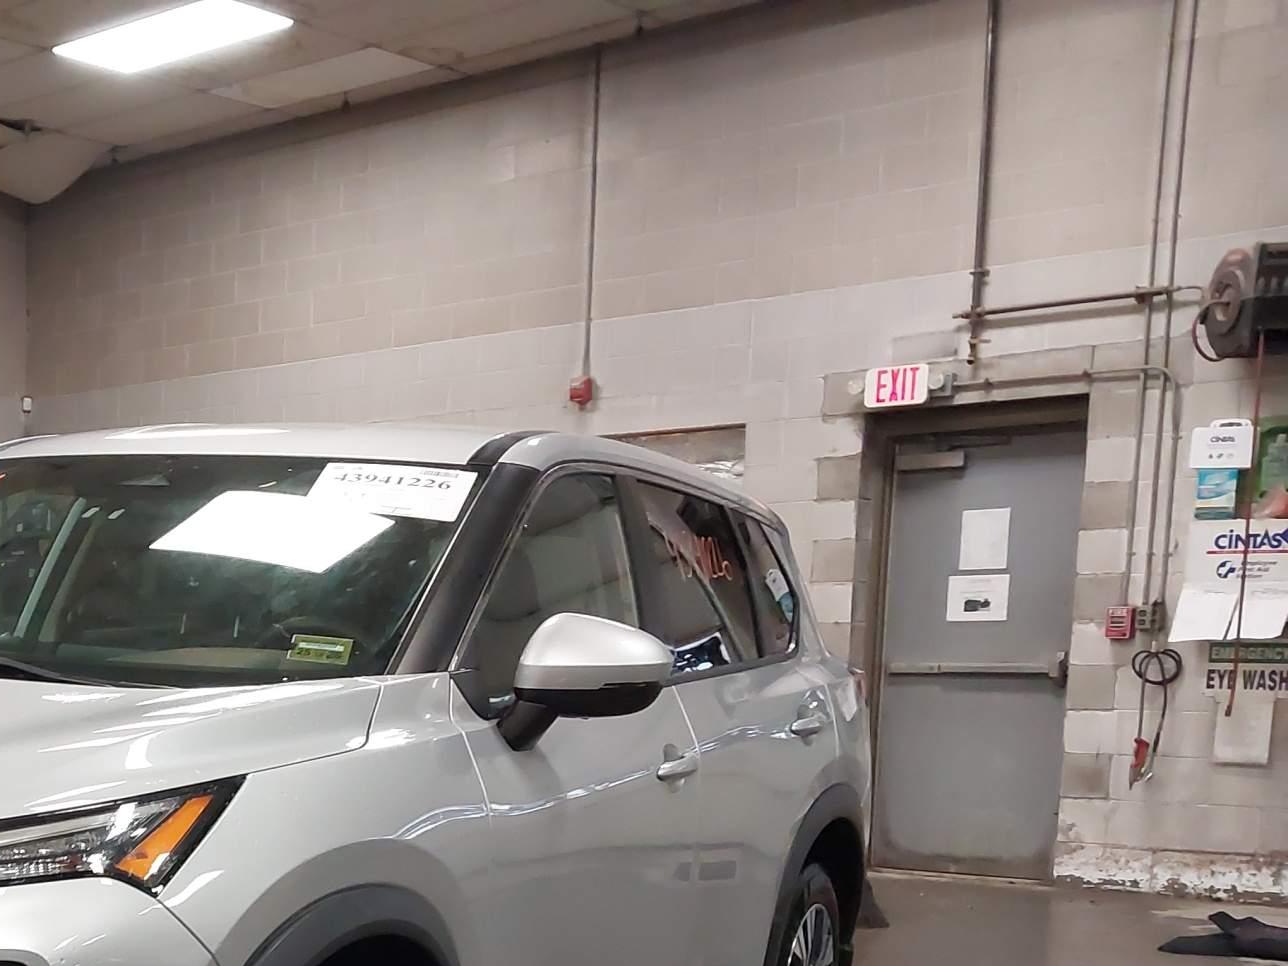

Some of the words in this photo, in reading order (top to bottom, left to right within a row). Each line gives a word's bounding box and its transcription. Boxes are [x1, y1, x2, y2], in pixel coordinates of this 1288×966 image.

[875, 367, 920, 403] EXIT
[333, 473, 452, 490] 43941226
[1243, 669, 1288, 691] WASH
